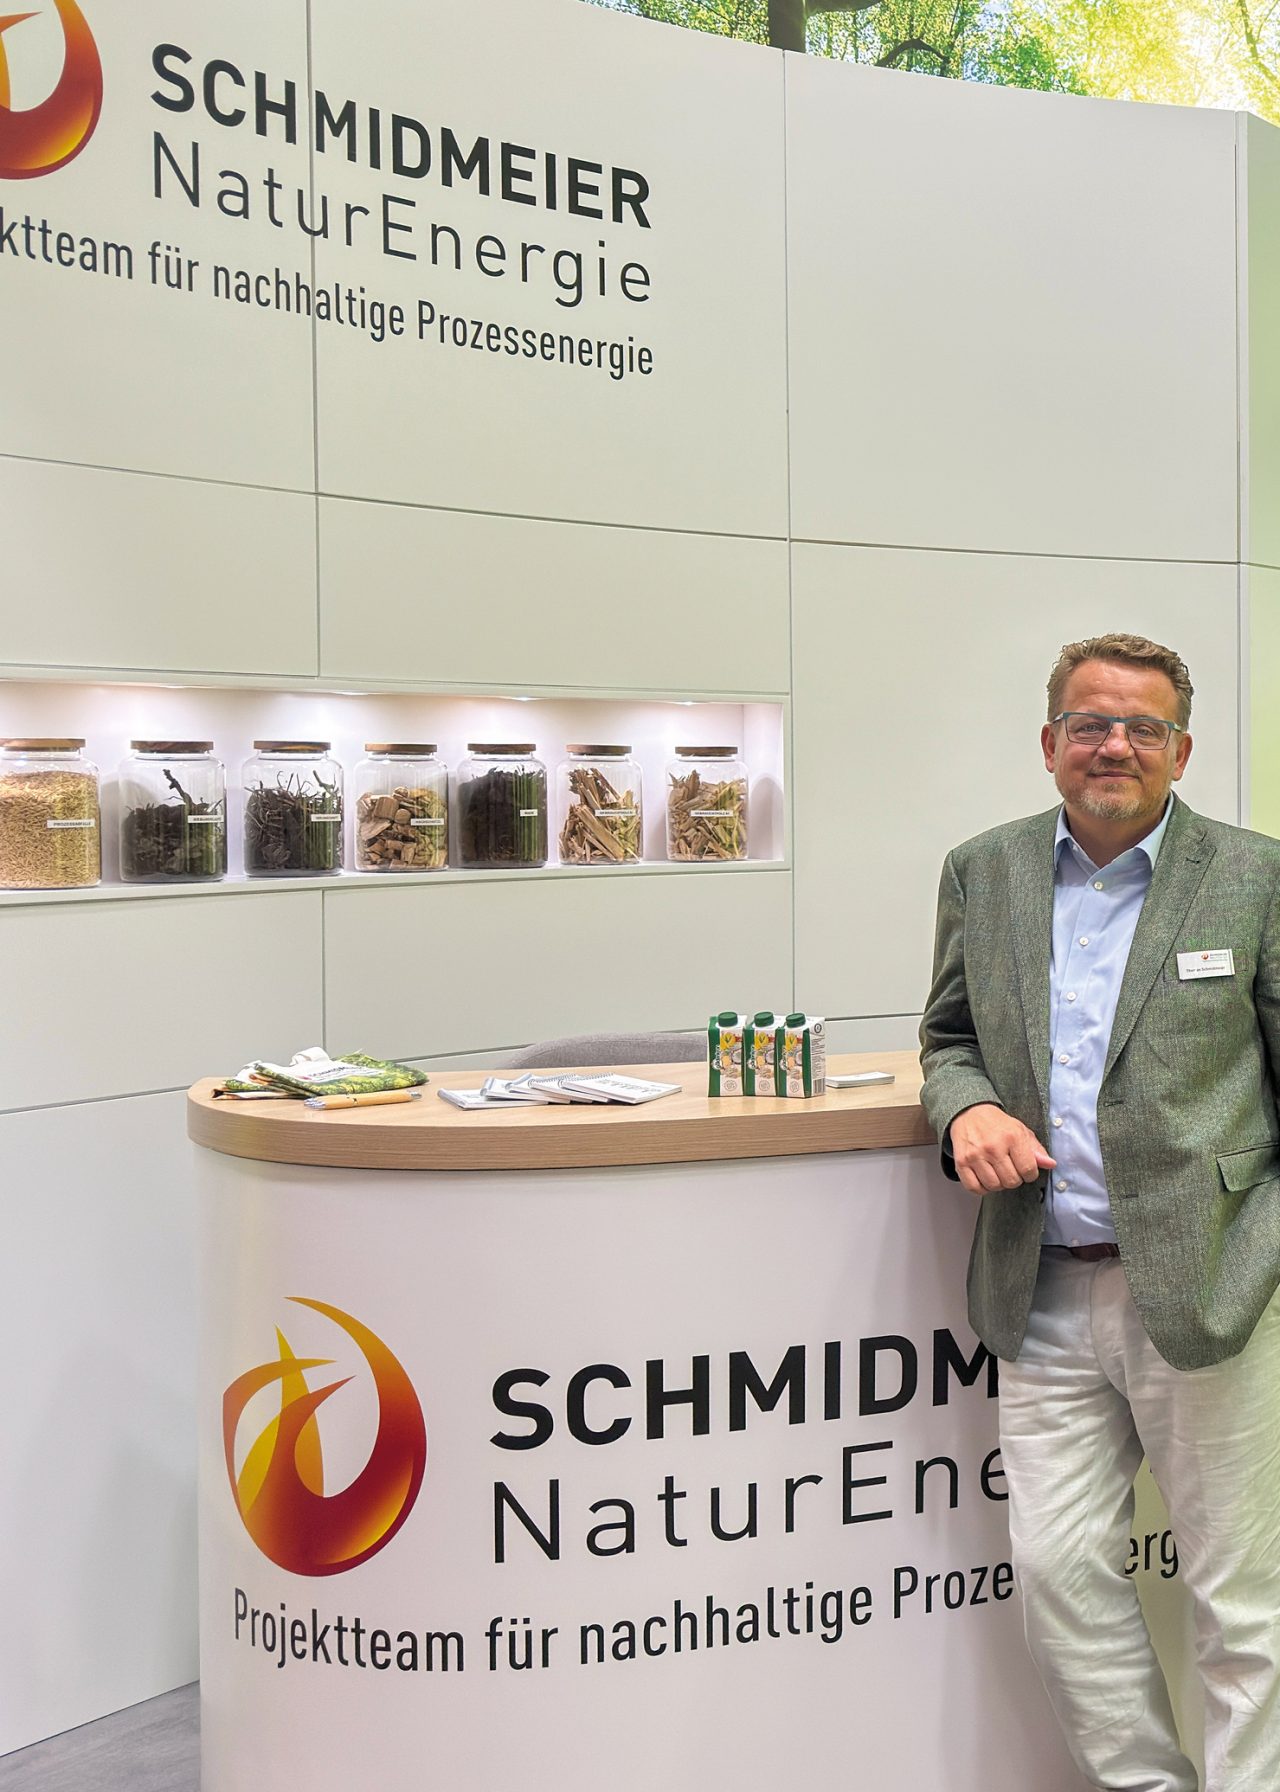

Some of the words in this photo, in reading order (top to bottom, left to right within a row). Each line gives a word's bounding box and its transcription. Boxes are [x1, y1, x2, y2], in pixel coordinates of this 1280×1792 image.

[150, 43, 652, 229] SCHMIDMEIER
[153, 131, 651, 308] NaturEnergie
[0, 206, 133, 280] ktteam
[147, 241, 199, 293] für
[214, 265, 404, 343] nachhaltige
[418, 299, 653, 381] Prozessenergie
[489, 1328, 999, 1451] SCHMIDM
[234, 1586, 464, 1673] Projektteam
[484, 1614, 559, 1672] für
[580, 1581, 872, 1666] nachhaltige
